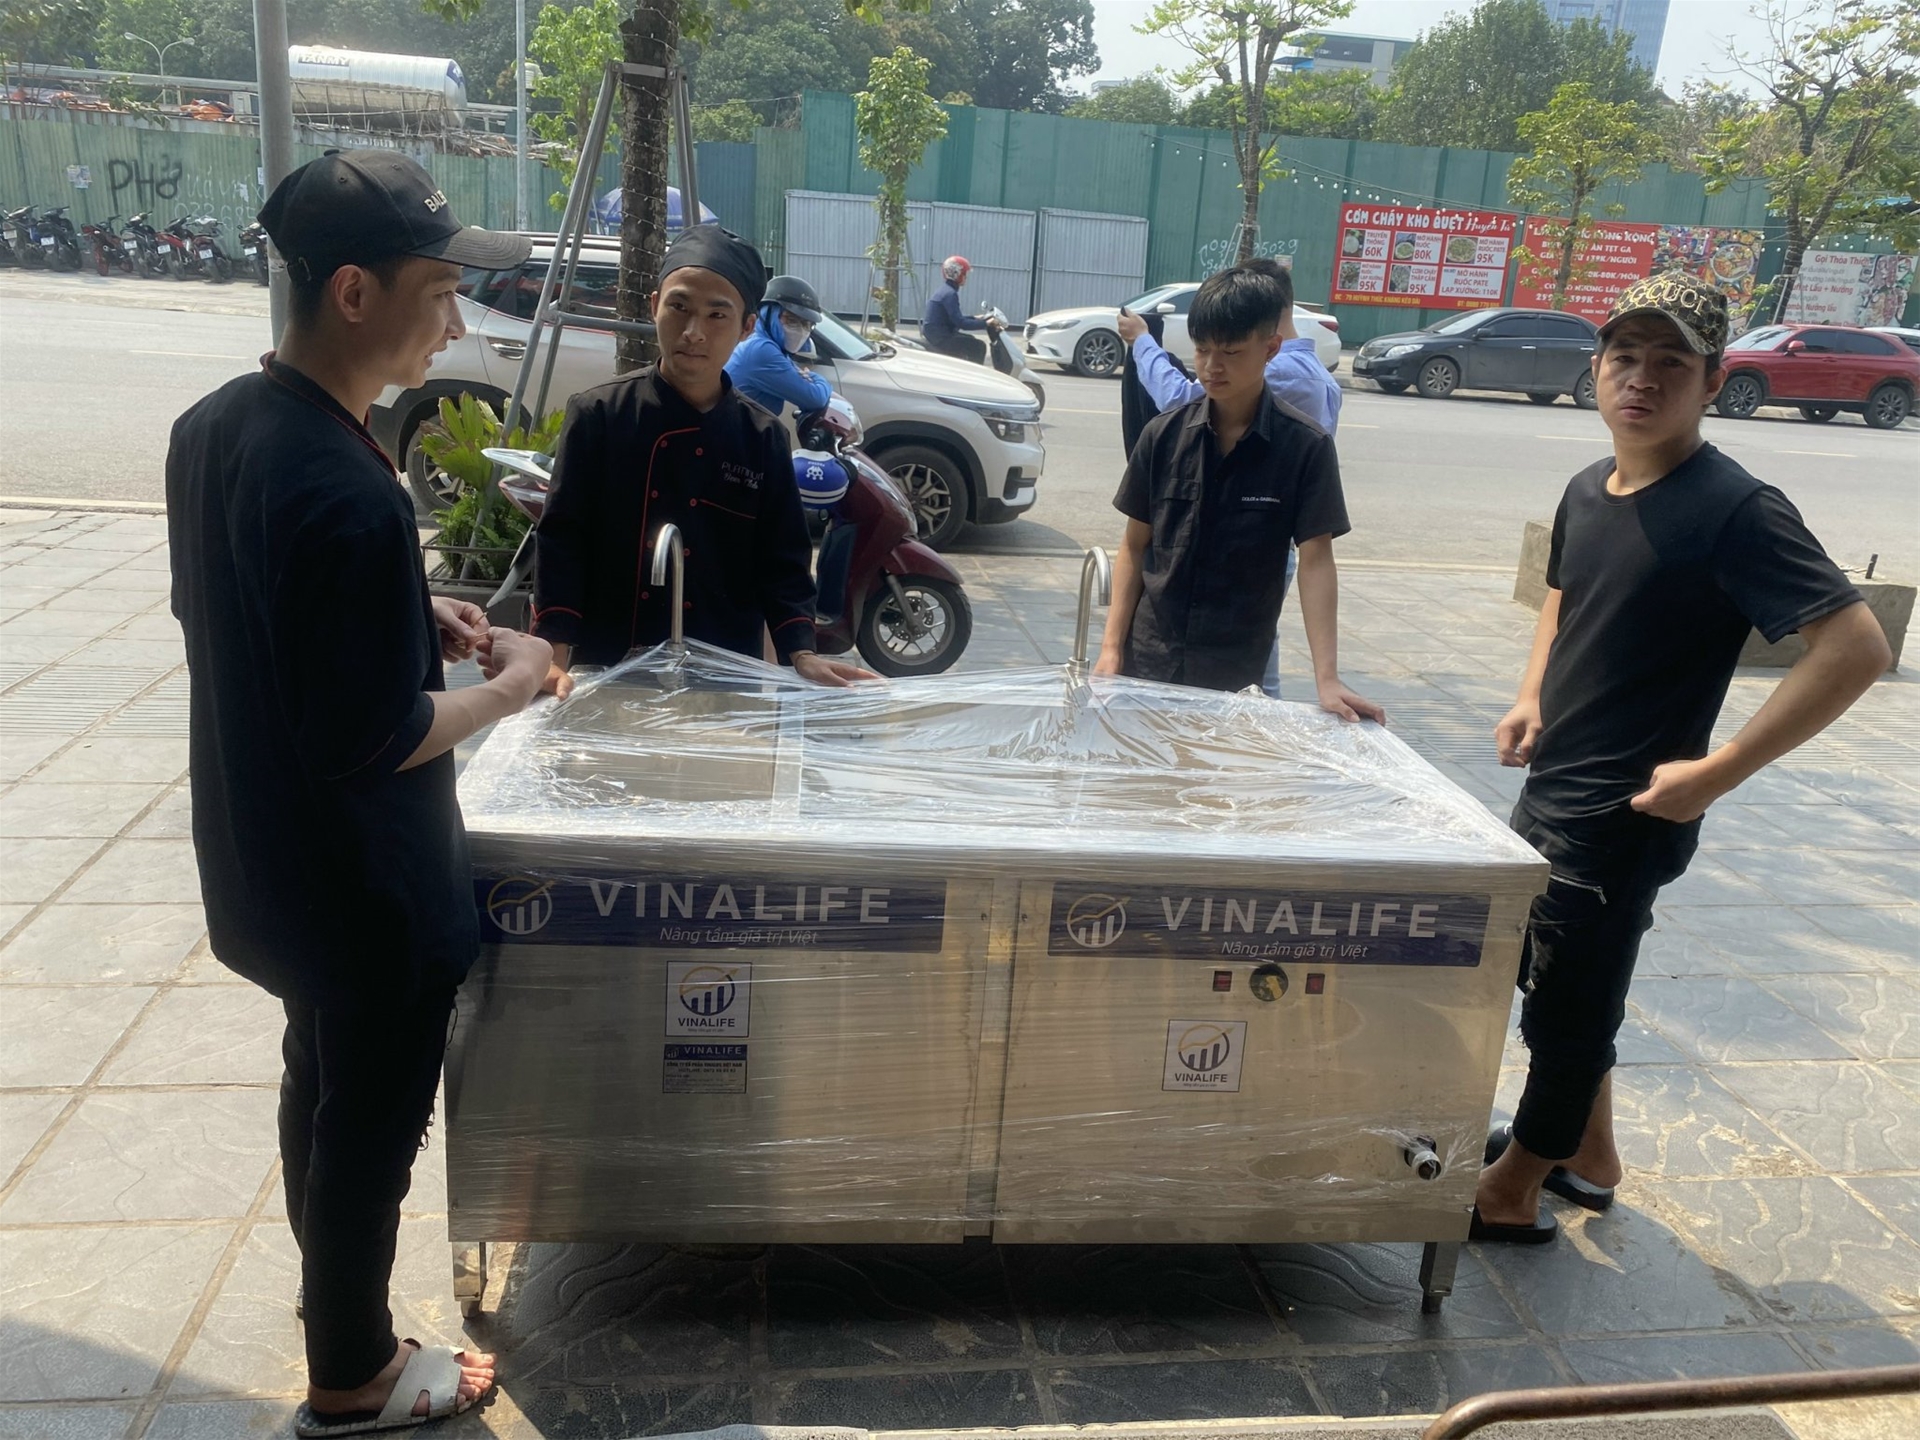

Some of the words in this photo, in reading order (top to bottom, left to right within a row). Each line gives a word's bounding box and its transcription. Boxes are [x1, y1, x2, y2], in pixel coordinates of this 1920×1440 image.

[1372, 209, 1404, 226] CHÁY
[1406, 214, 1430, 228] KHO
[1365, 246, 1383, 257] 60K
[1414, 249, 1432, 260] 80K
[1477, 253, 1494, 263] 95K
[1359, 281, 1377, 291] 95K
[1409, 283, 1427, 294] 95K
[1473, 279, 1489, 287] PATE
[588, 881, 891, 924] VINALIFE
[1161, 896, 1440, 938] VINALIFE
[659, 926, 700, 945] Nâng
[787, 929, 819, 946] Việt
[1221, 940, 1259, 958] Nâng
[1263, 939, 1292, 956] tầm
[1293, 942, 1316, 959] giá
[1320, 944, 1335, 959] trị
[1339, 943, 1369, 959] Việt
[678, 1017, 736, 1028] VINALIFE
[684, 1046, 742, 1055] VINALIFE
[1175, 1073, 1228, 1083] VINALIFE
